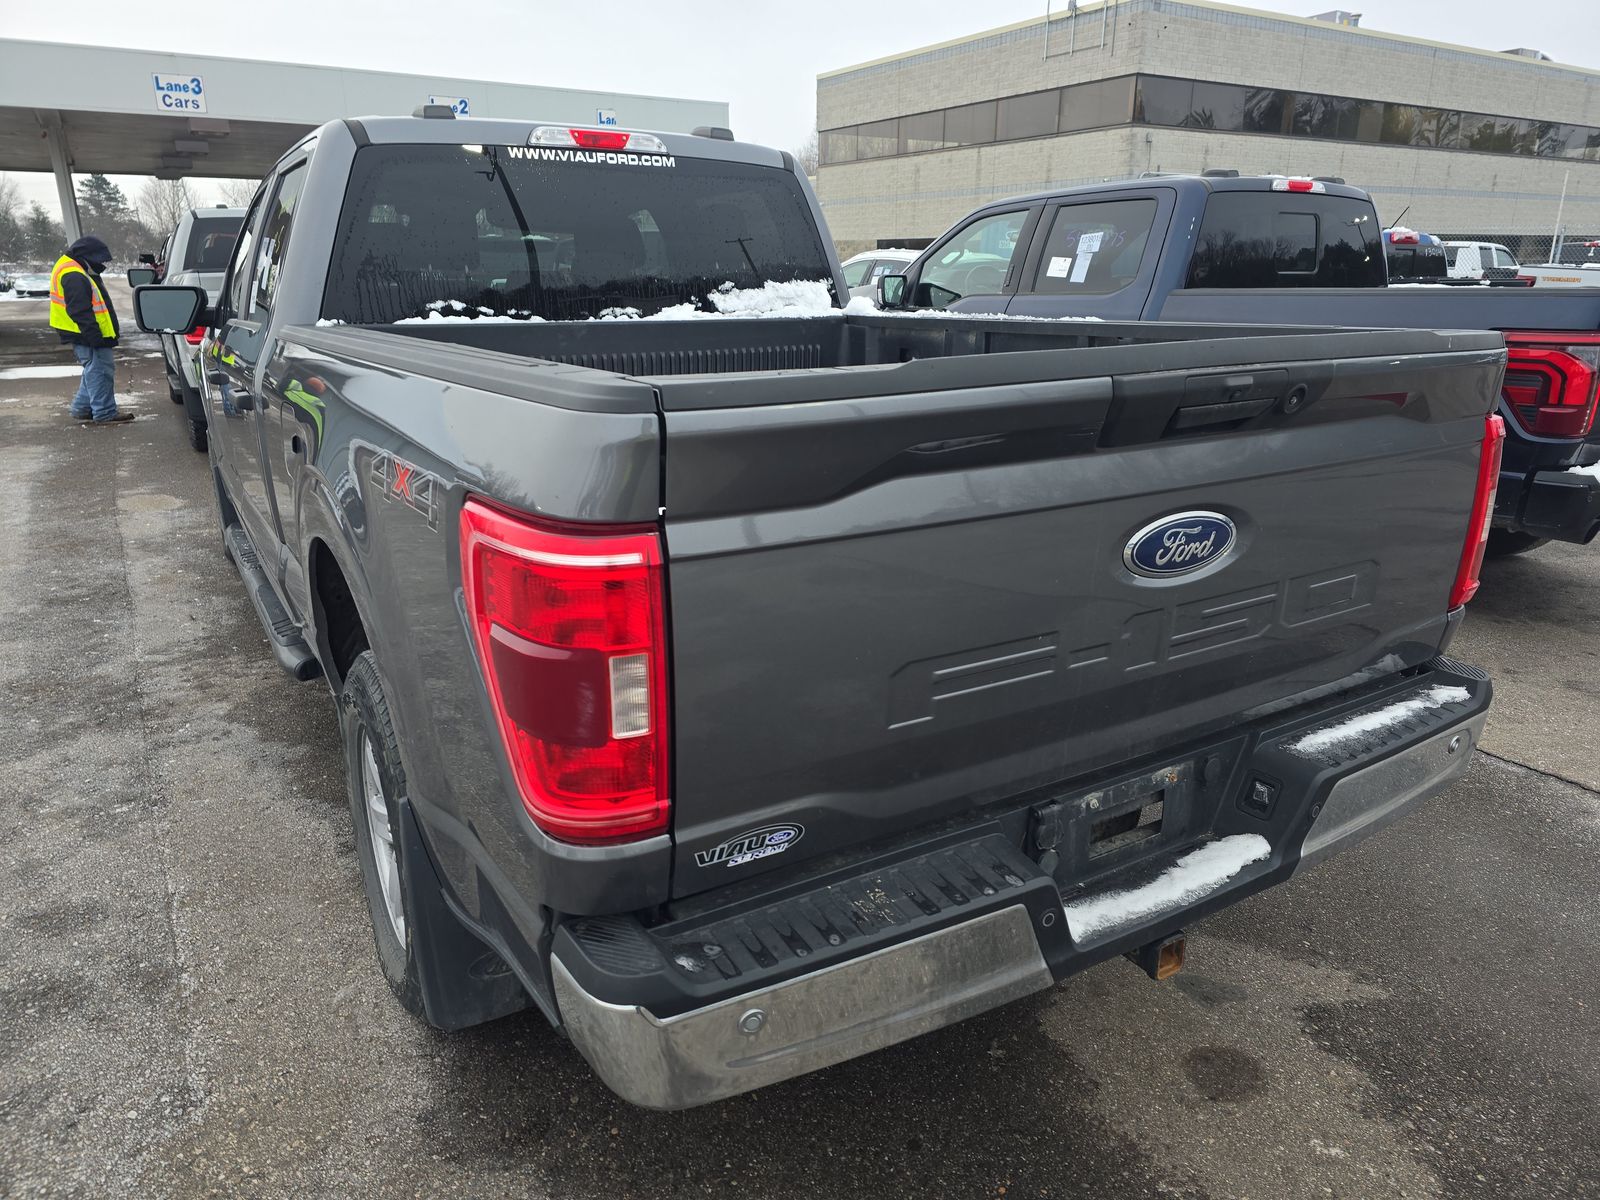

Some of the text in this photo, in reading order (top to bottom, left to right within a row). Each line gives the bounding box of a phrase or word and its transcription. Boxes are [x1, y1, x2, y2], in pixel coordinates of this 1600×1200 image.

[162, 93, 200, 110] Cars
[507, 145, 677, 168] WWW.VIAUFORD.COM
[886, 559, 1381, 731] F-150
[694, 832, 771, 868] VIAU
